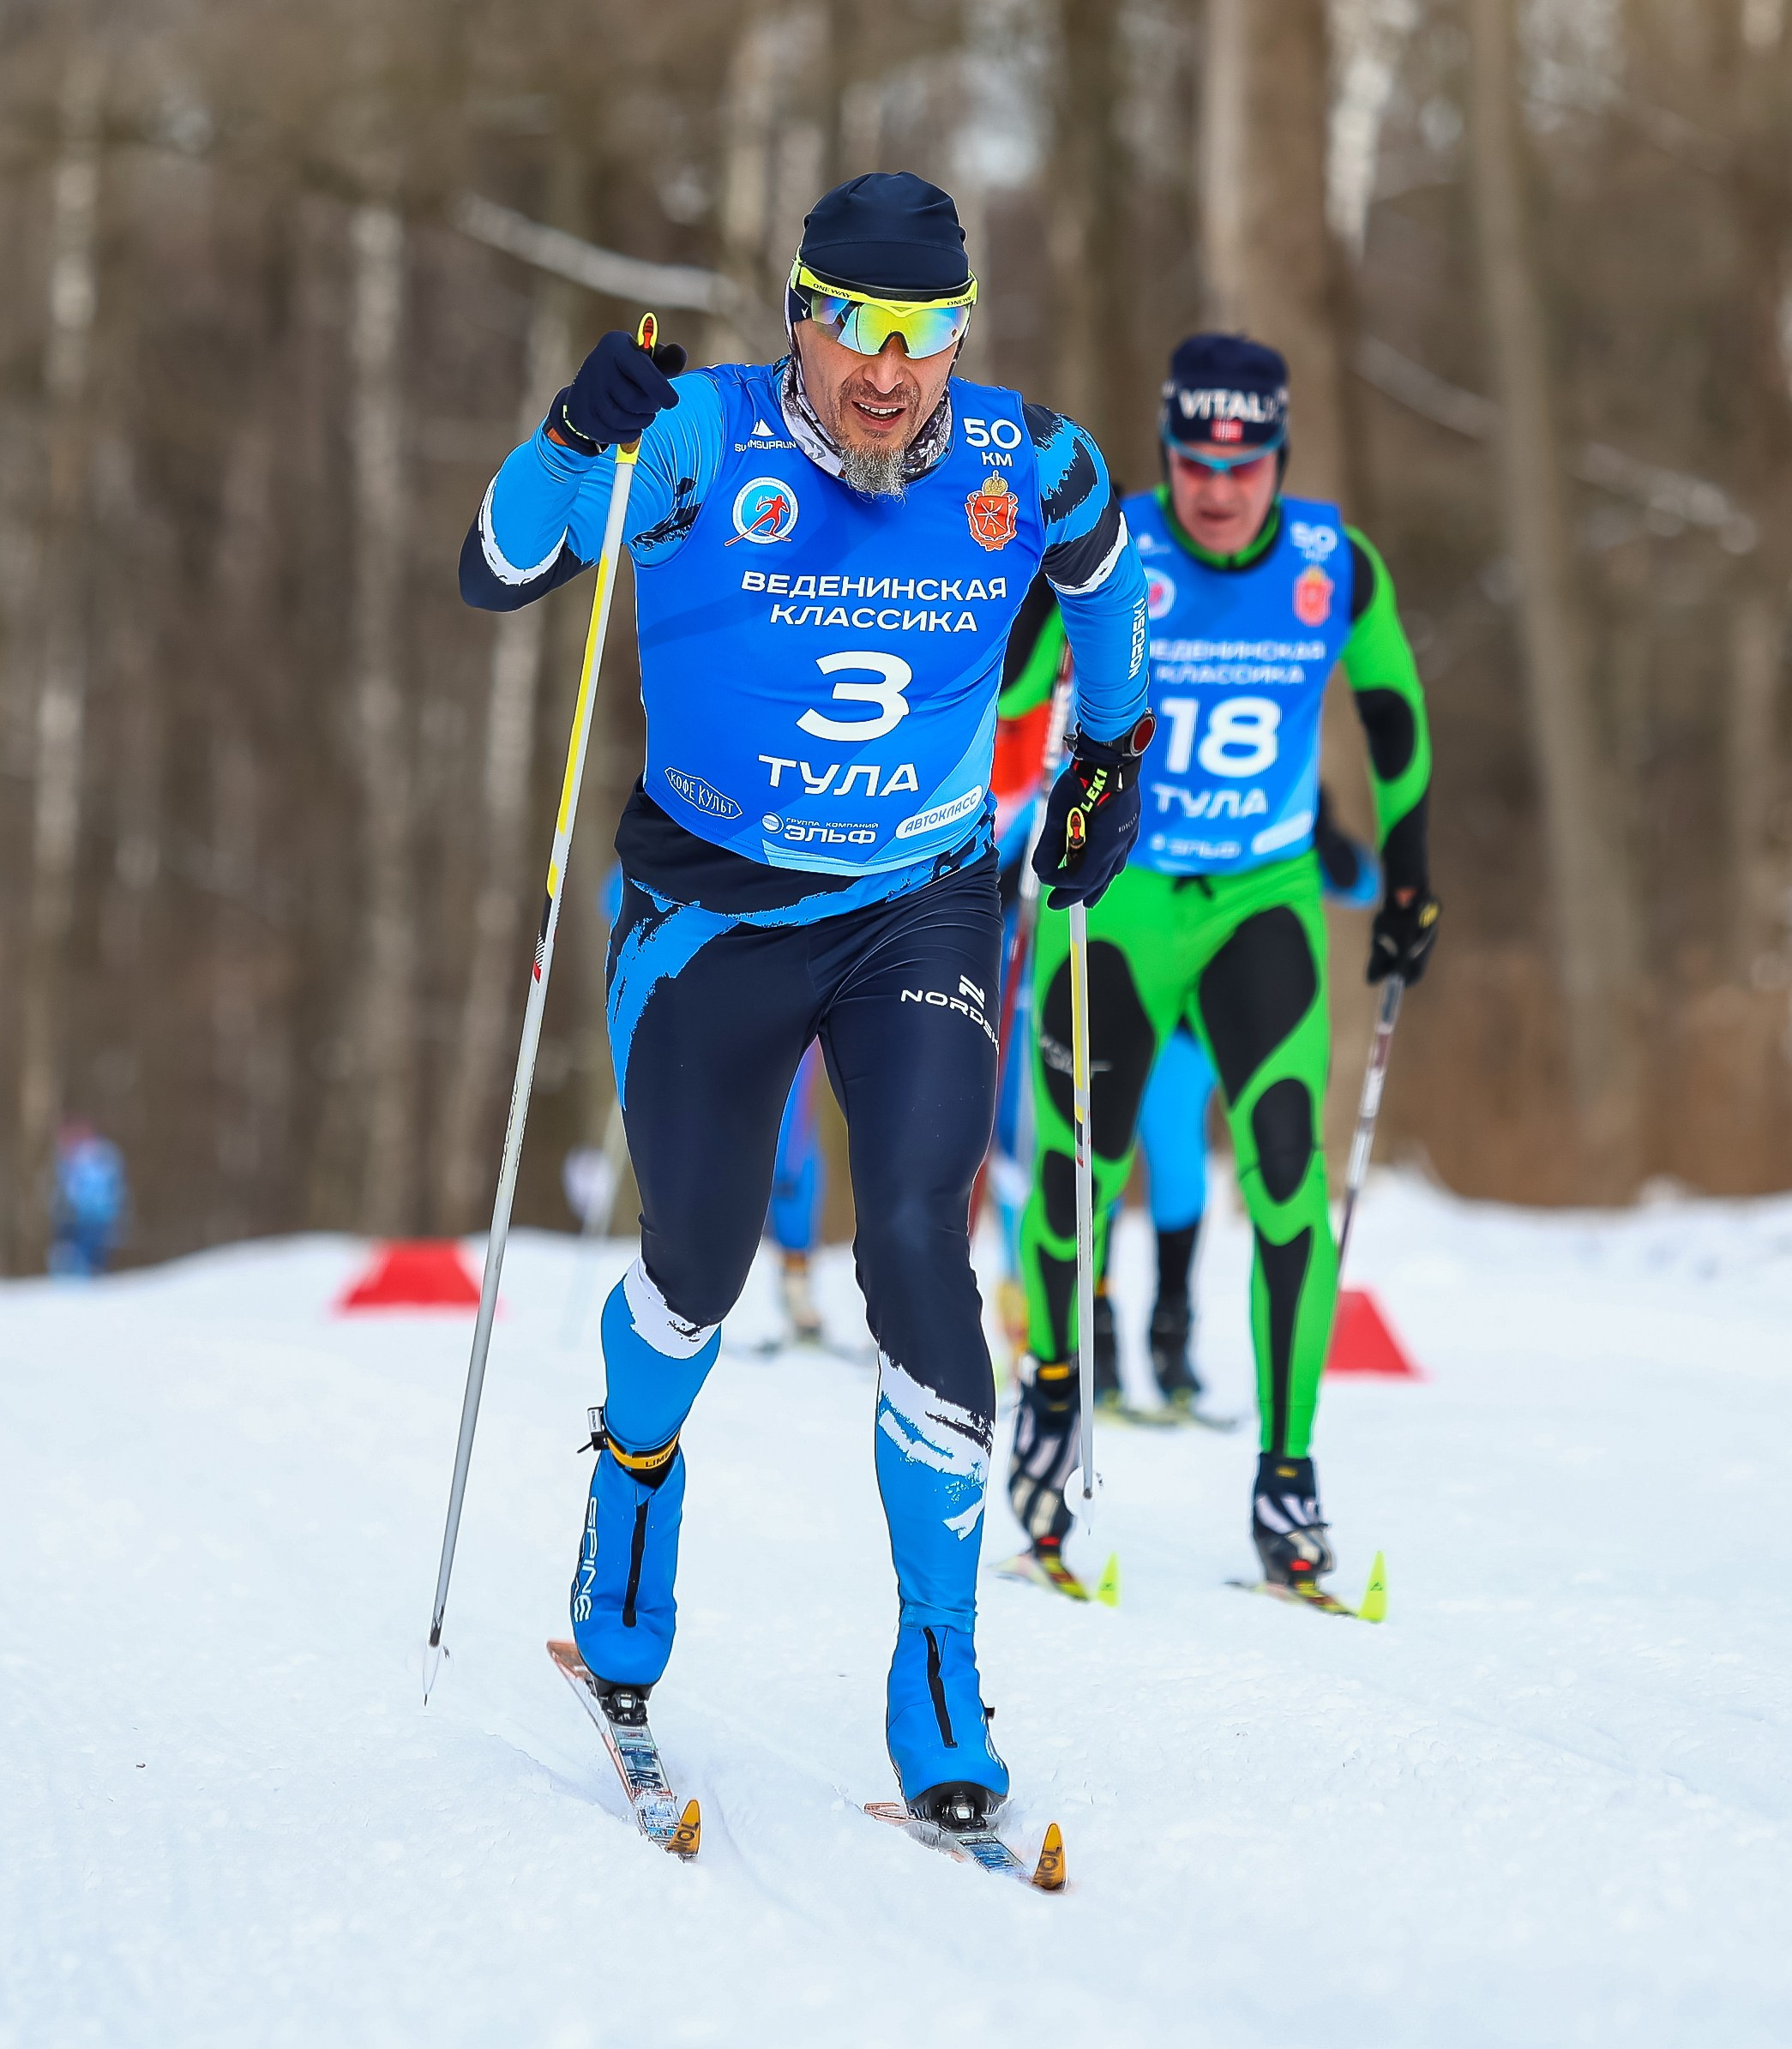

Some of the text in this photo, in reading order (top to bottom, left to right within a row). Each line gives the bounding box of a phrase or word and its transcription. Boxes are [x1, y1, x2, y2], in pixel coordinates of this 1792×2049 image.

[963, 418, 1022, 449] 50
[741, 570, 1007, 601] ВЕДЕНИНСКАЯ
[769, 604, 978, 633] КЛАССИКА
[1128, 597, 1146, 680] NORDSKI
[796, 650, 913, 742] 3
[1159, 696, 1282, 778] 18
[670, 771, 734, 814] КОФЕ КУЛЬТ
[758, 754, 919, 796] ТУЛА
[1080, 768, 1108, 813] LEKI
[905, 792, 977, 833] АВТОКЛАСС
[1152, 782, 1268, 819] ТУЛА
[784, 825, 877, 844] ЭЛЬФ
[785, 817, 821, 827] ГРУППА
[574, 1496, 598, 1623] SPINE
